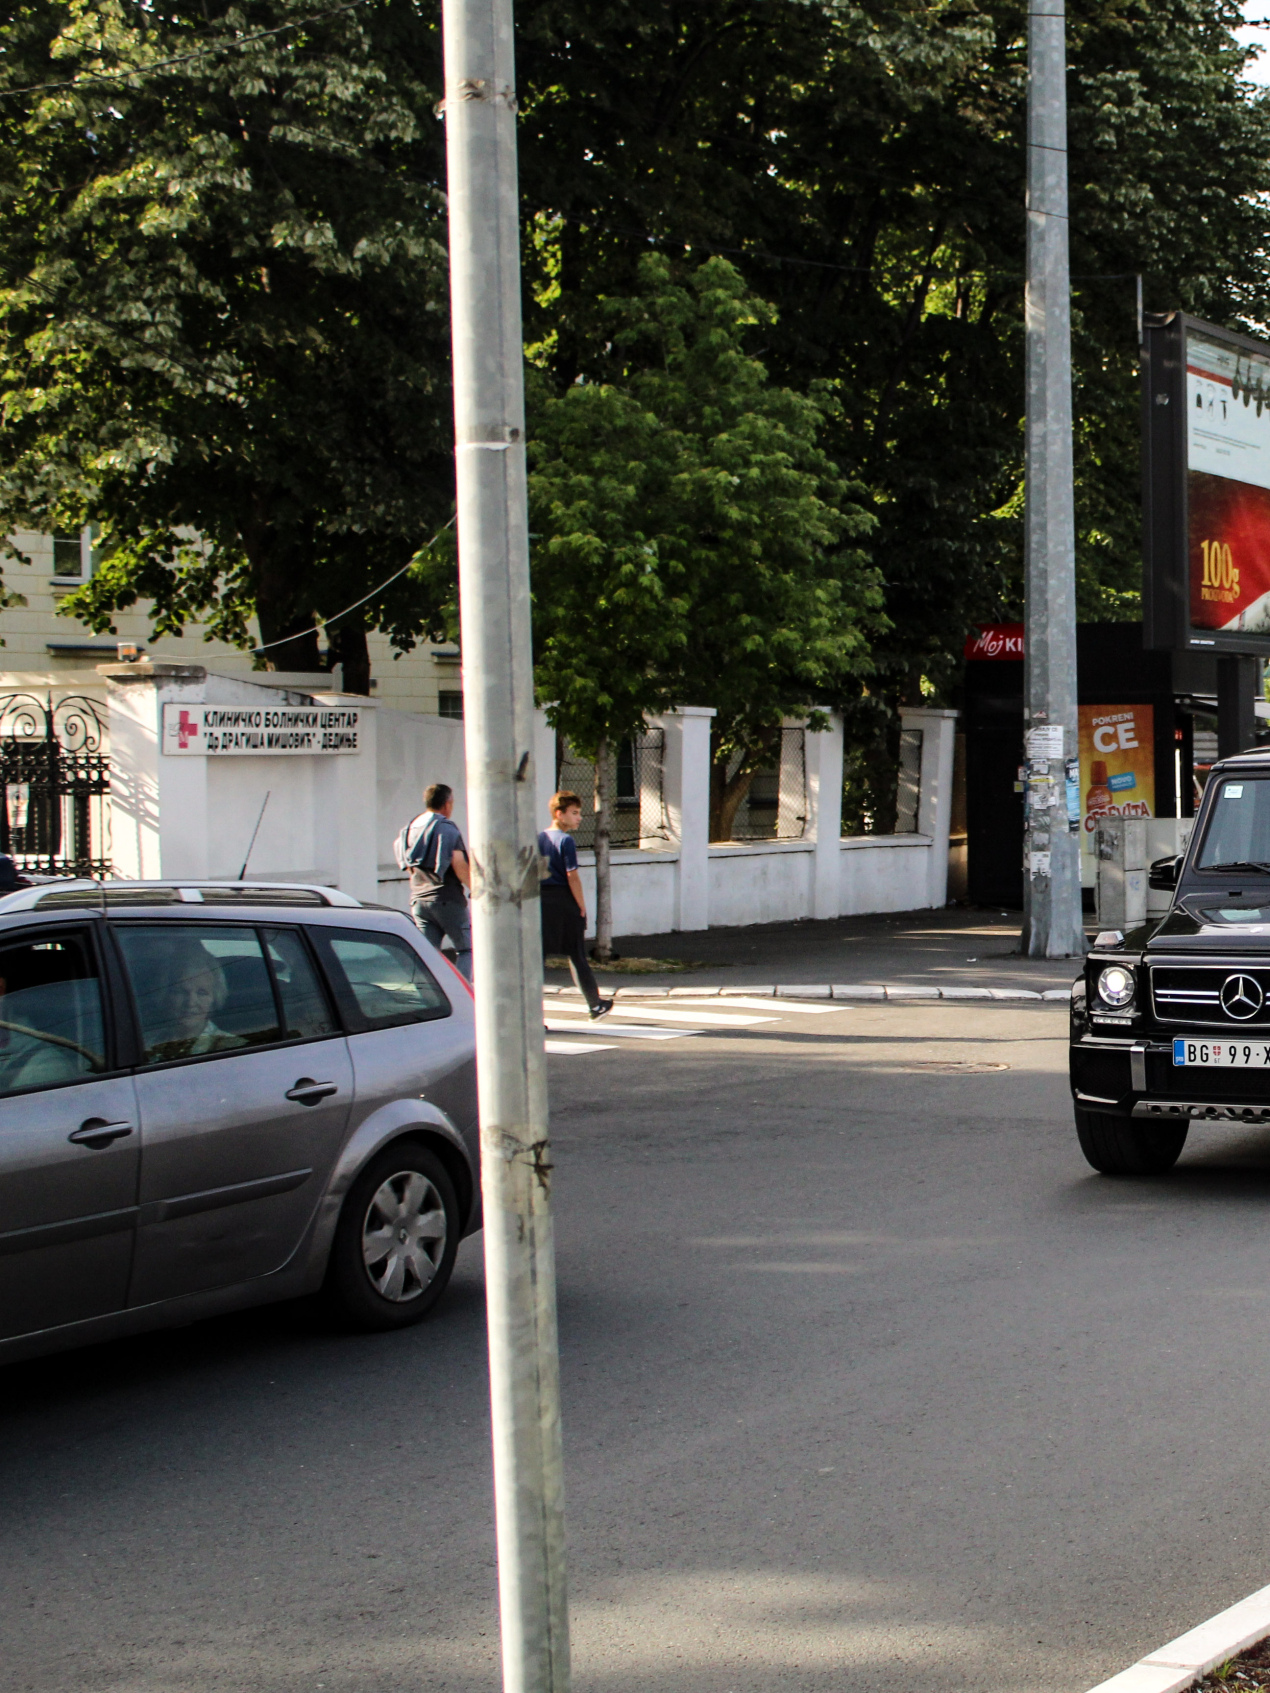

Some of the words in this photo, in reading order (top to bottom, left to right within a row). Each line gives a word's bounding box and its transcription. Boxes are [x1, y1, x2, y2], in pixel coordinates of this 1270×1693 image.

[1200, 539, 1240, 599] 100g
[973, 631, 1004, 657] Moj
[203, 710, 262, 728] КЛИНИЧКО
[264, 711, 318, 729] БОЛНИЧКИ
[319, 712, 358, 731] ЦЕНТАР
[1092, 711, 1134, 727] POKRENI
[220, 732, 265, 751] ДРАГИША
[321, 732, 358, 751] ДЕДИЊЕ
[1093, 722, 1140, 753] CE
[1111, 775, 1132, 786] NOVO
[1188, 1043, 1209, 1063] BG
